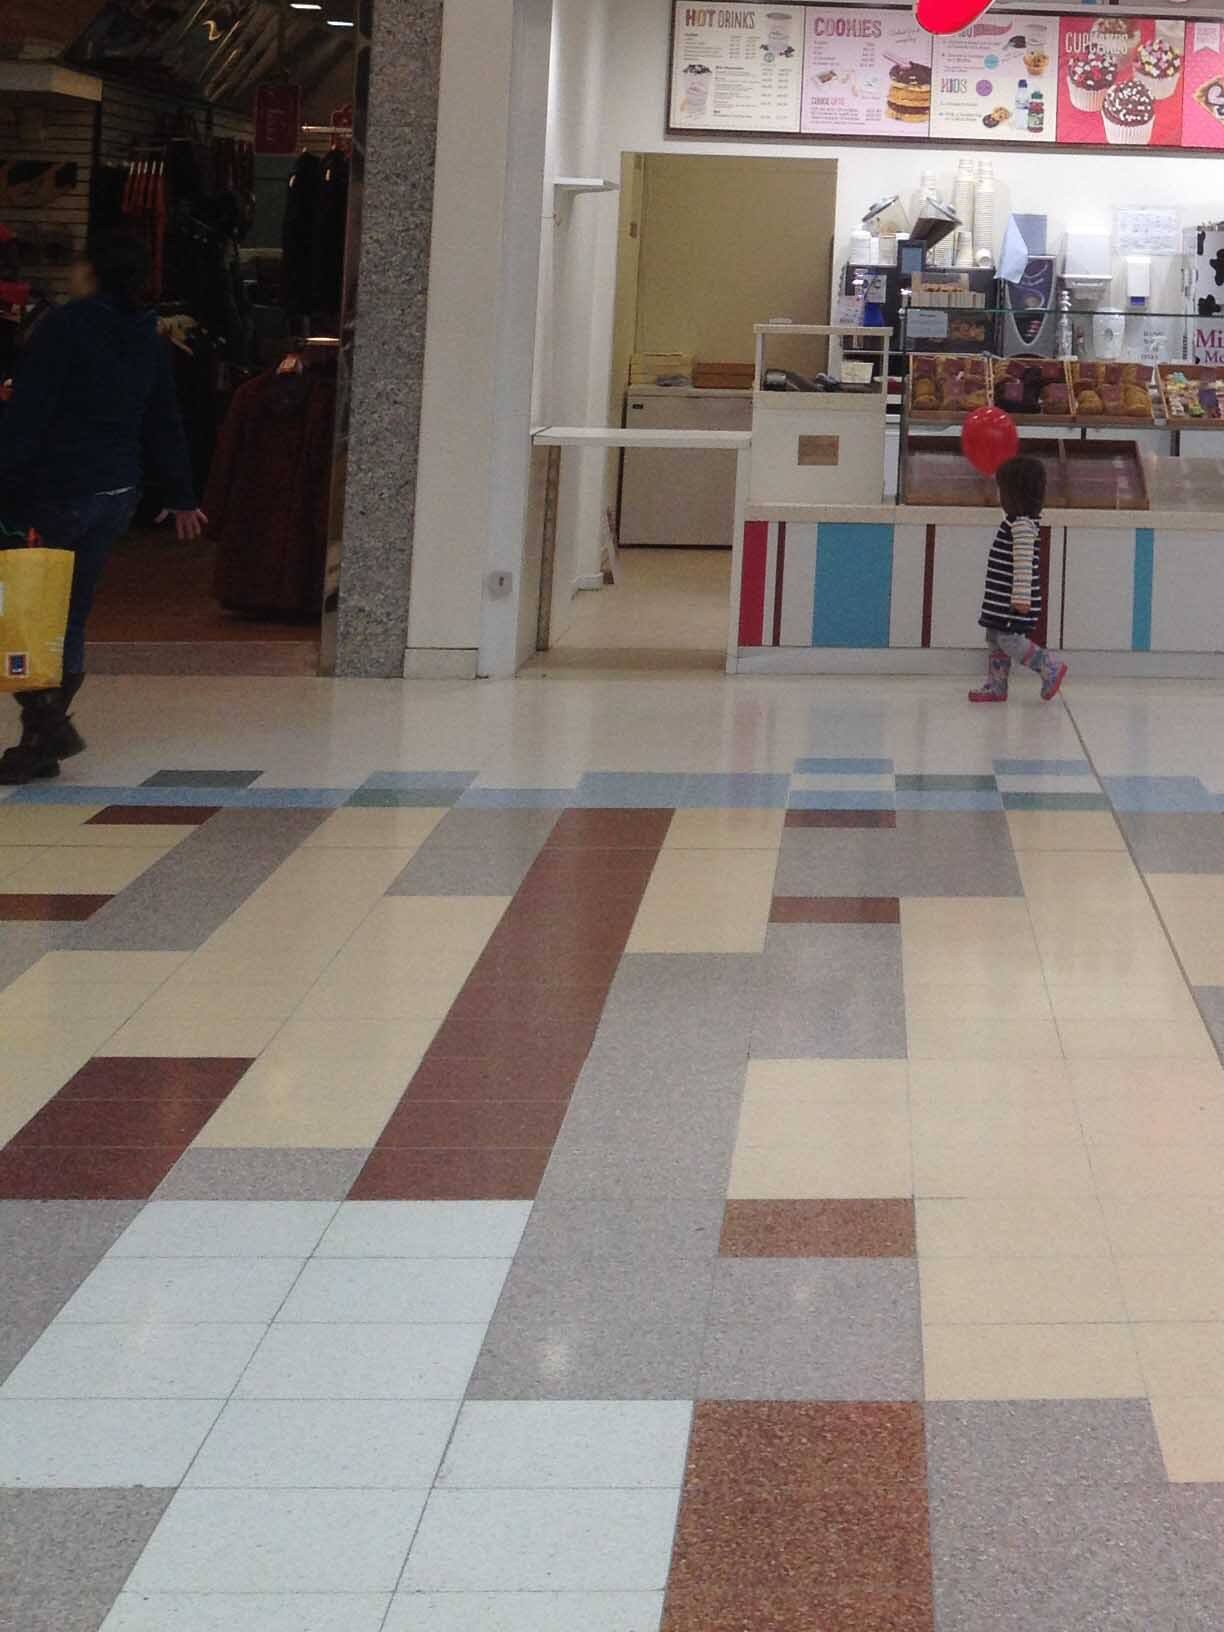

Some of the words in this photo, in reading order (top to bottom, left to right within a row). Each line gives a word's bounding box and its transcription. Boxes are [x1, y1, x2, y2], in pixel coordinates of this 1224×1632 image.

[685, 9, 716, 27] HOT
[718, 10, 755, 29] DRINKS
[814, 17, 882, 38] COOKIES
[1065, 32, 1128, 54] CUPCAKES
